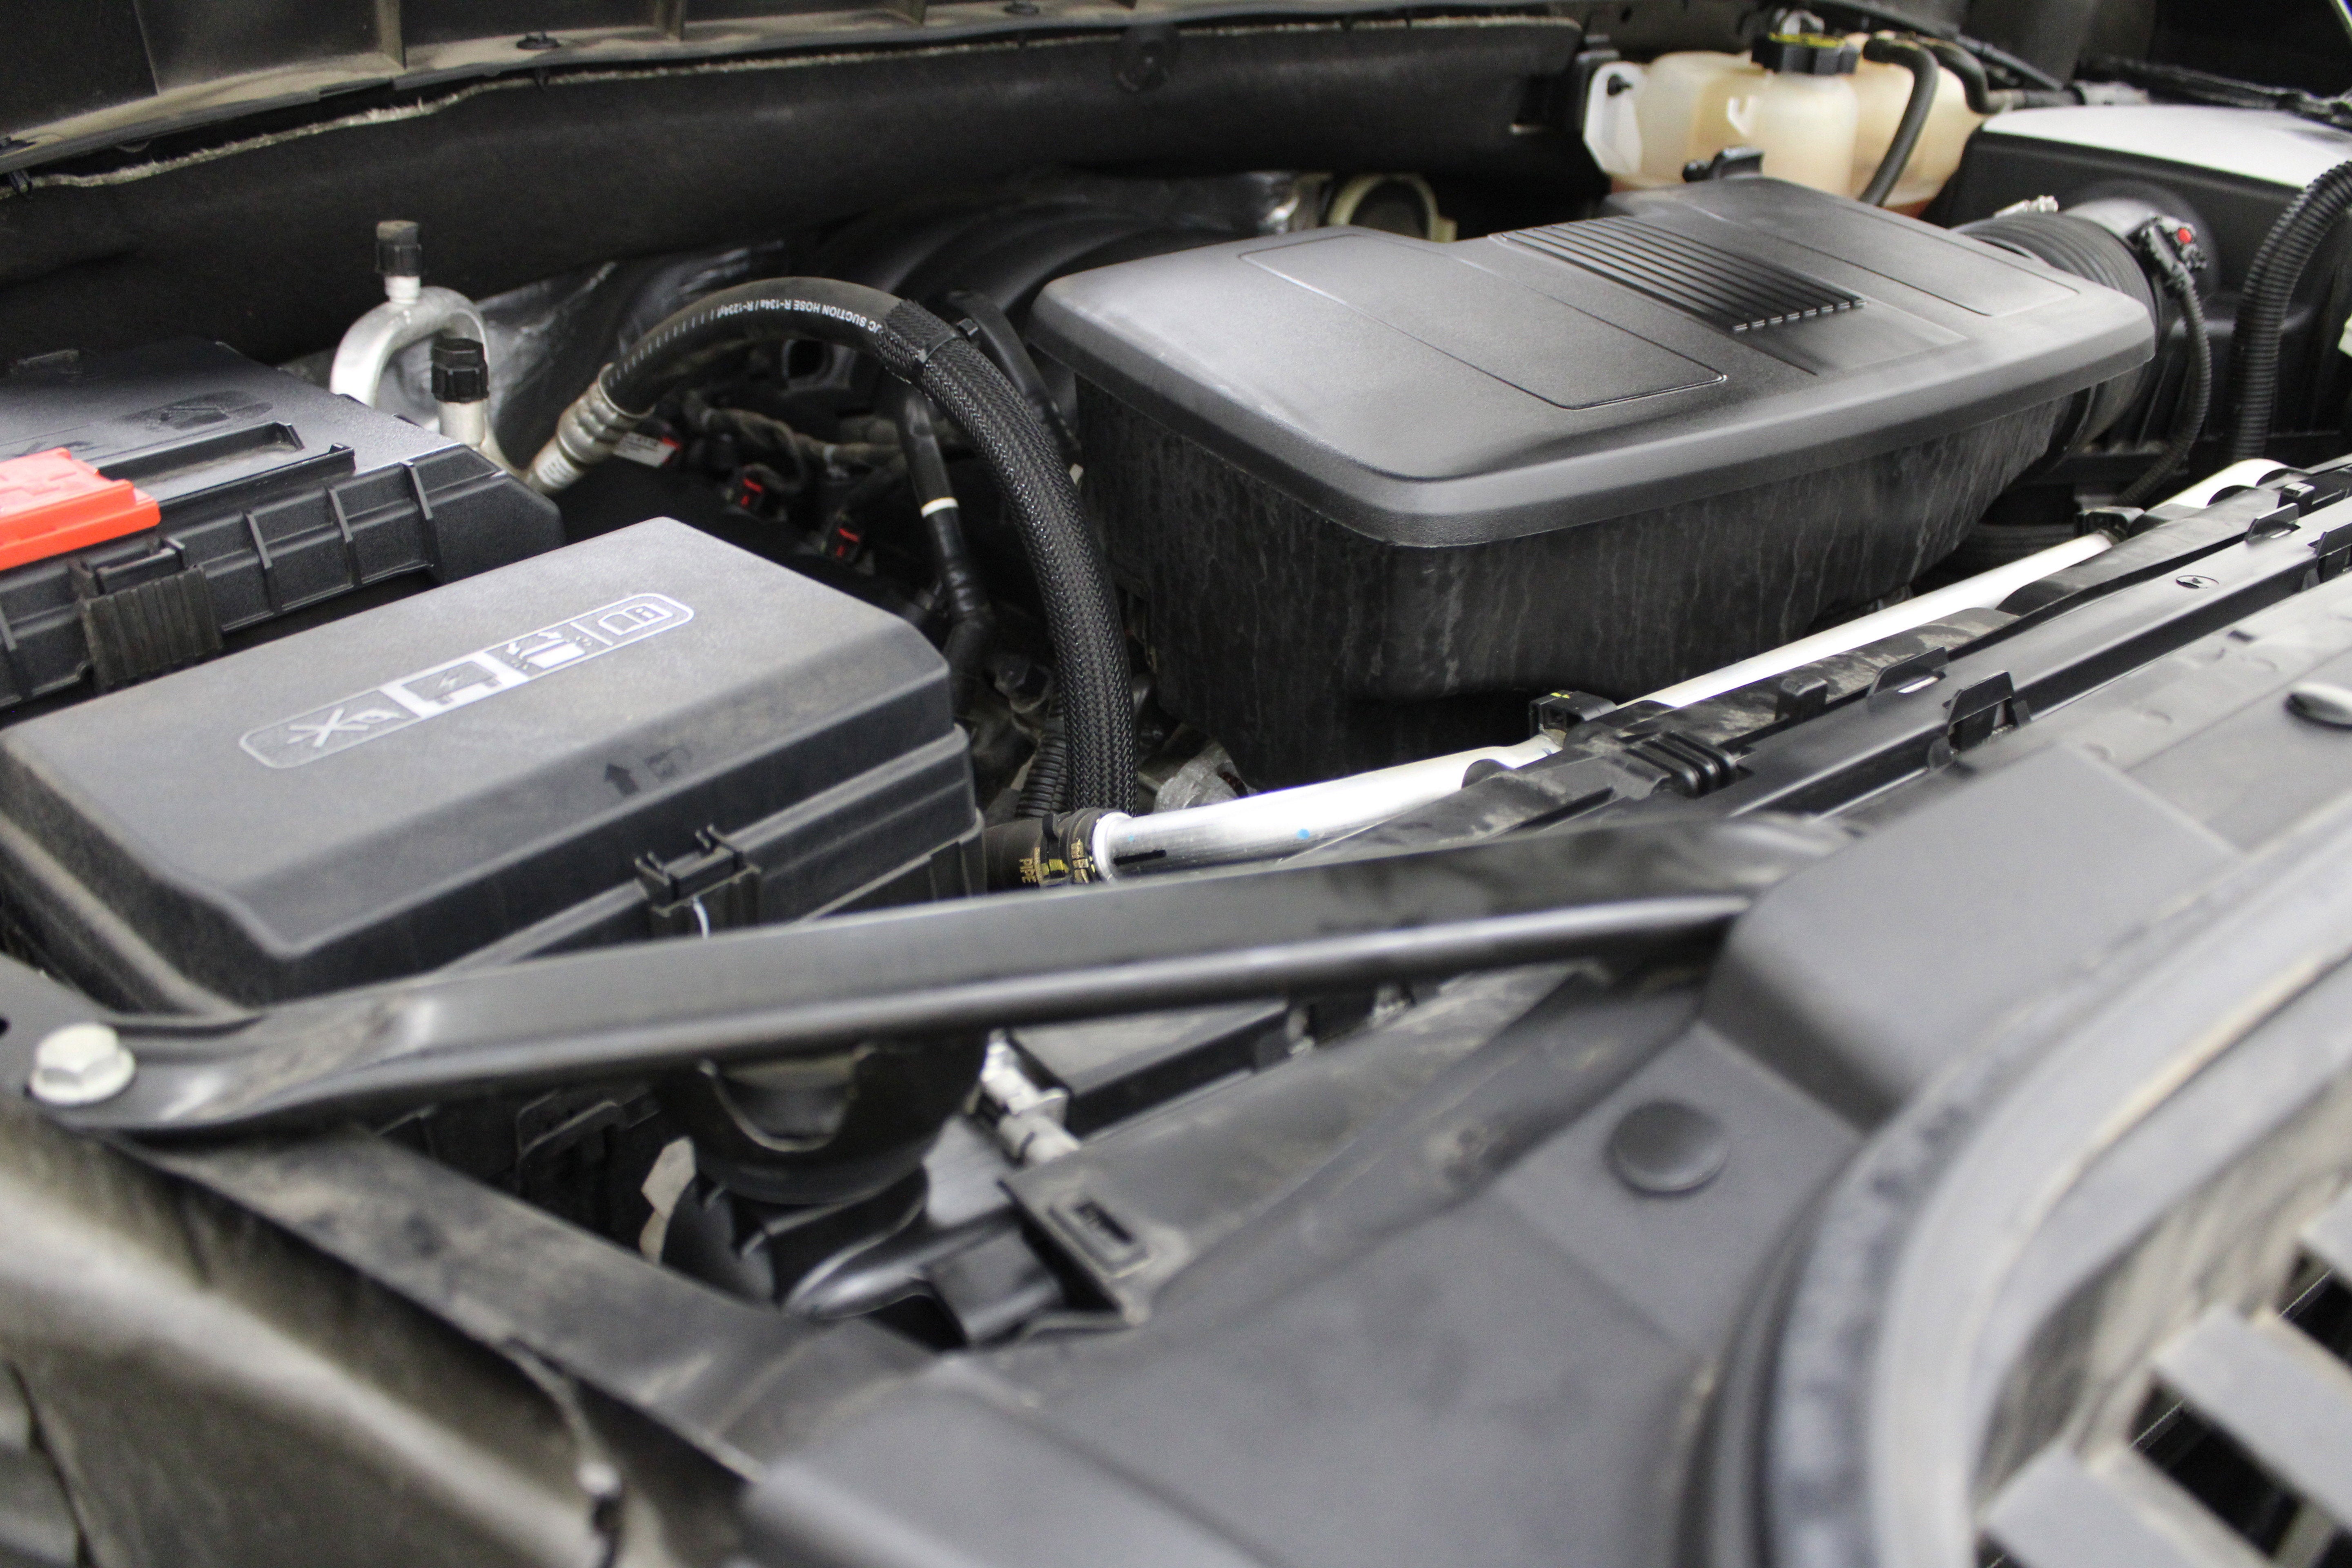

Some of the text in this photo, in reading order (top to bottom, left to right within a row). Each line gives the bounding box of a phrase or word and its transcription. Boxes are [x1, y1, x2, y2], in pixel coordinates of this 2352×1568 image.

[760, 298, 792, 310] R-134a
[793, 299, 821, 314] HOSE
[821, 304, 868, 327] SUCTION
[1019, 857, 1037, 884] PIPE
